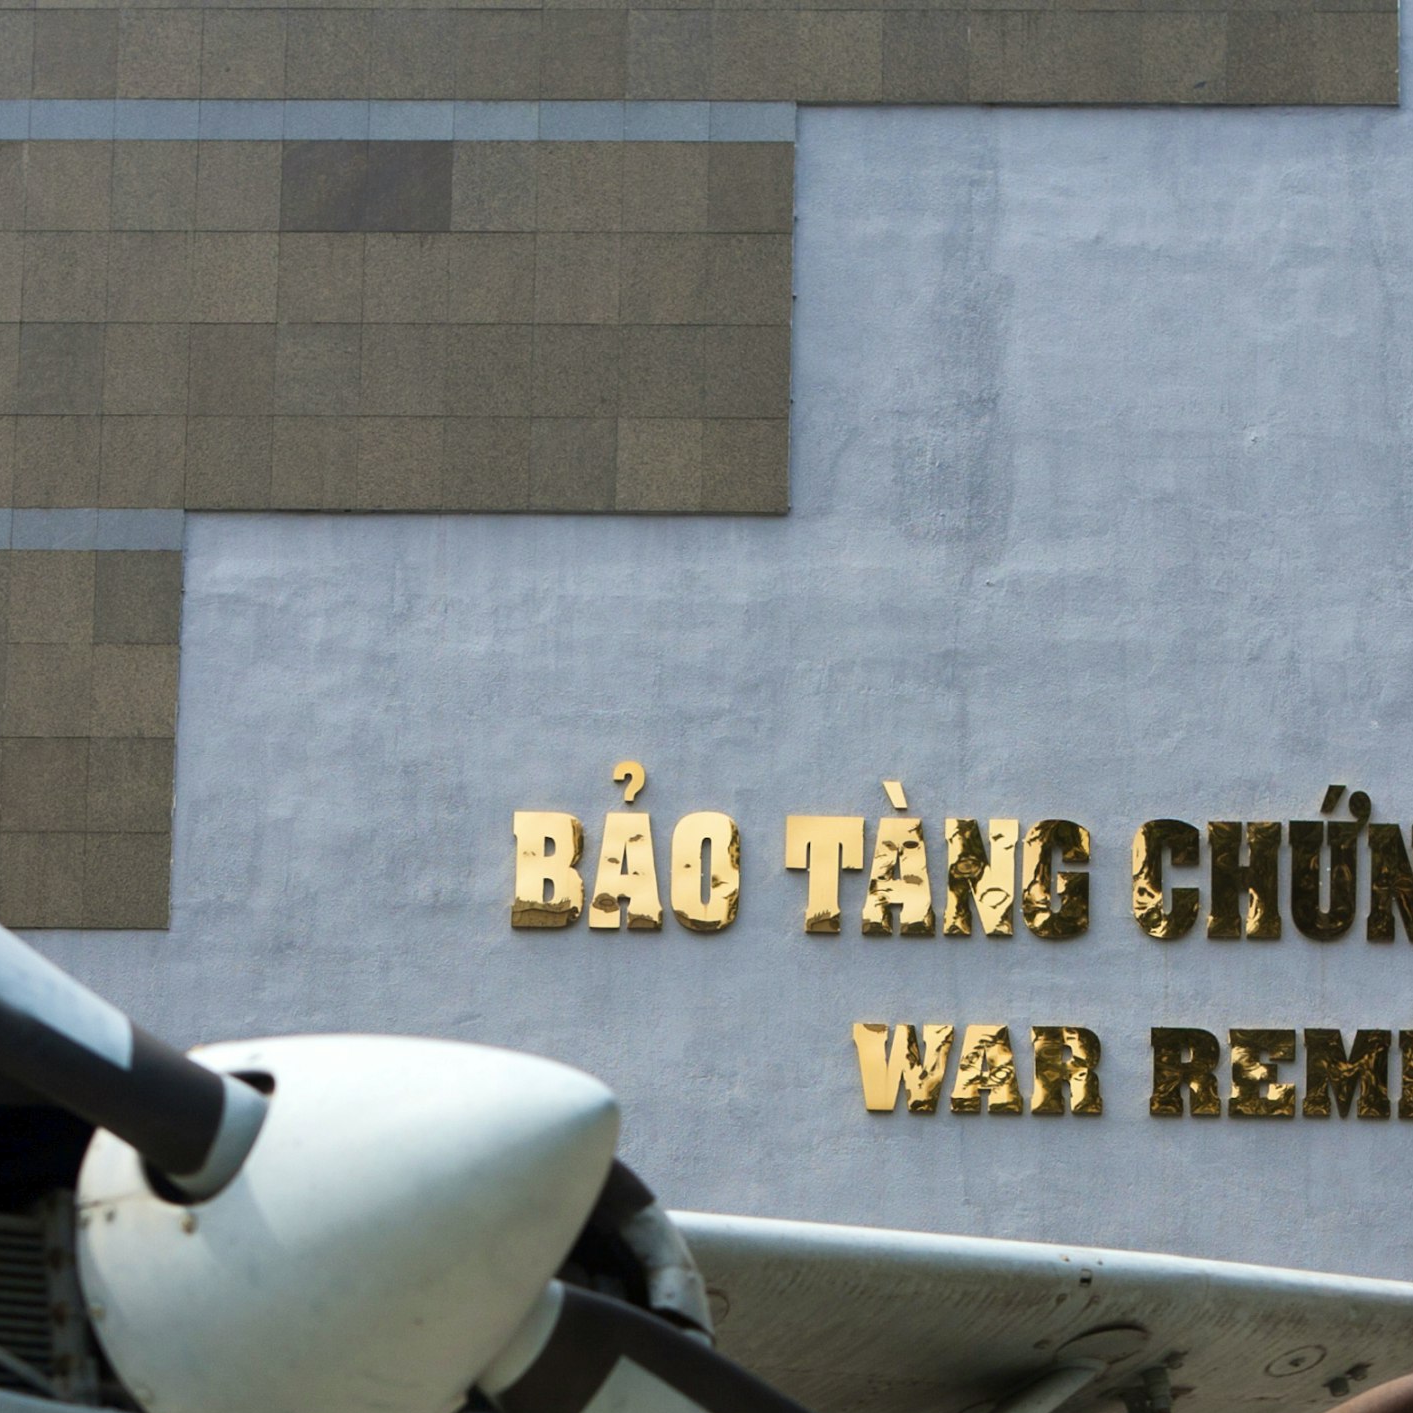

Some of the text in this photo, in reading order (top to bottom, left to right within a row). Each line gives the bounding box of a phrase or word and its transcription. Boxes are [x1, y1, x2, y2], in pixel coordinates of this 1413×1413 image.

[511, 761, 741, 933] BẢO
[786, 781, 1090, 939] TÀNG
[853, 1022, 1104, 1115] WAR
